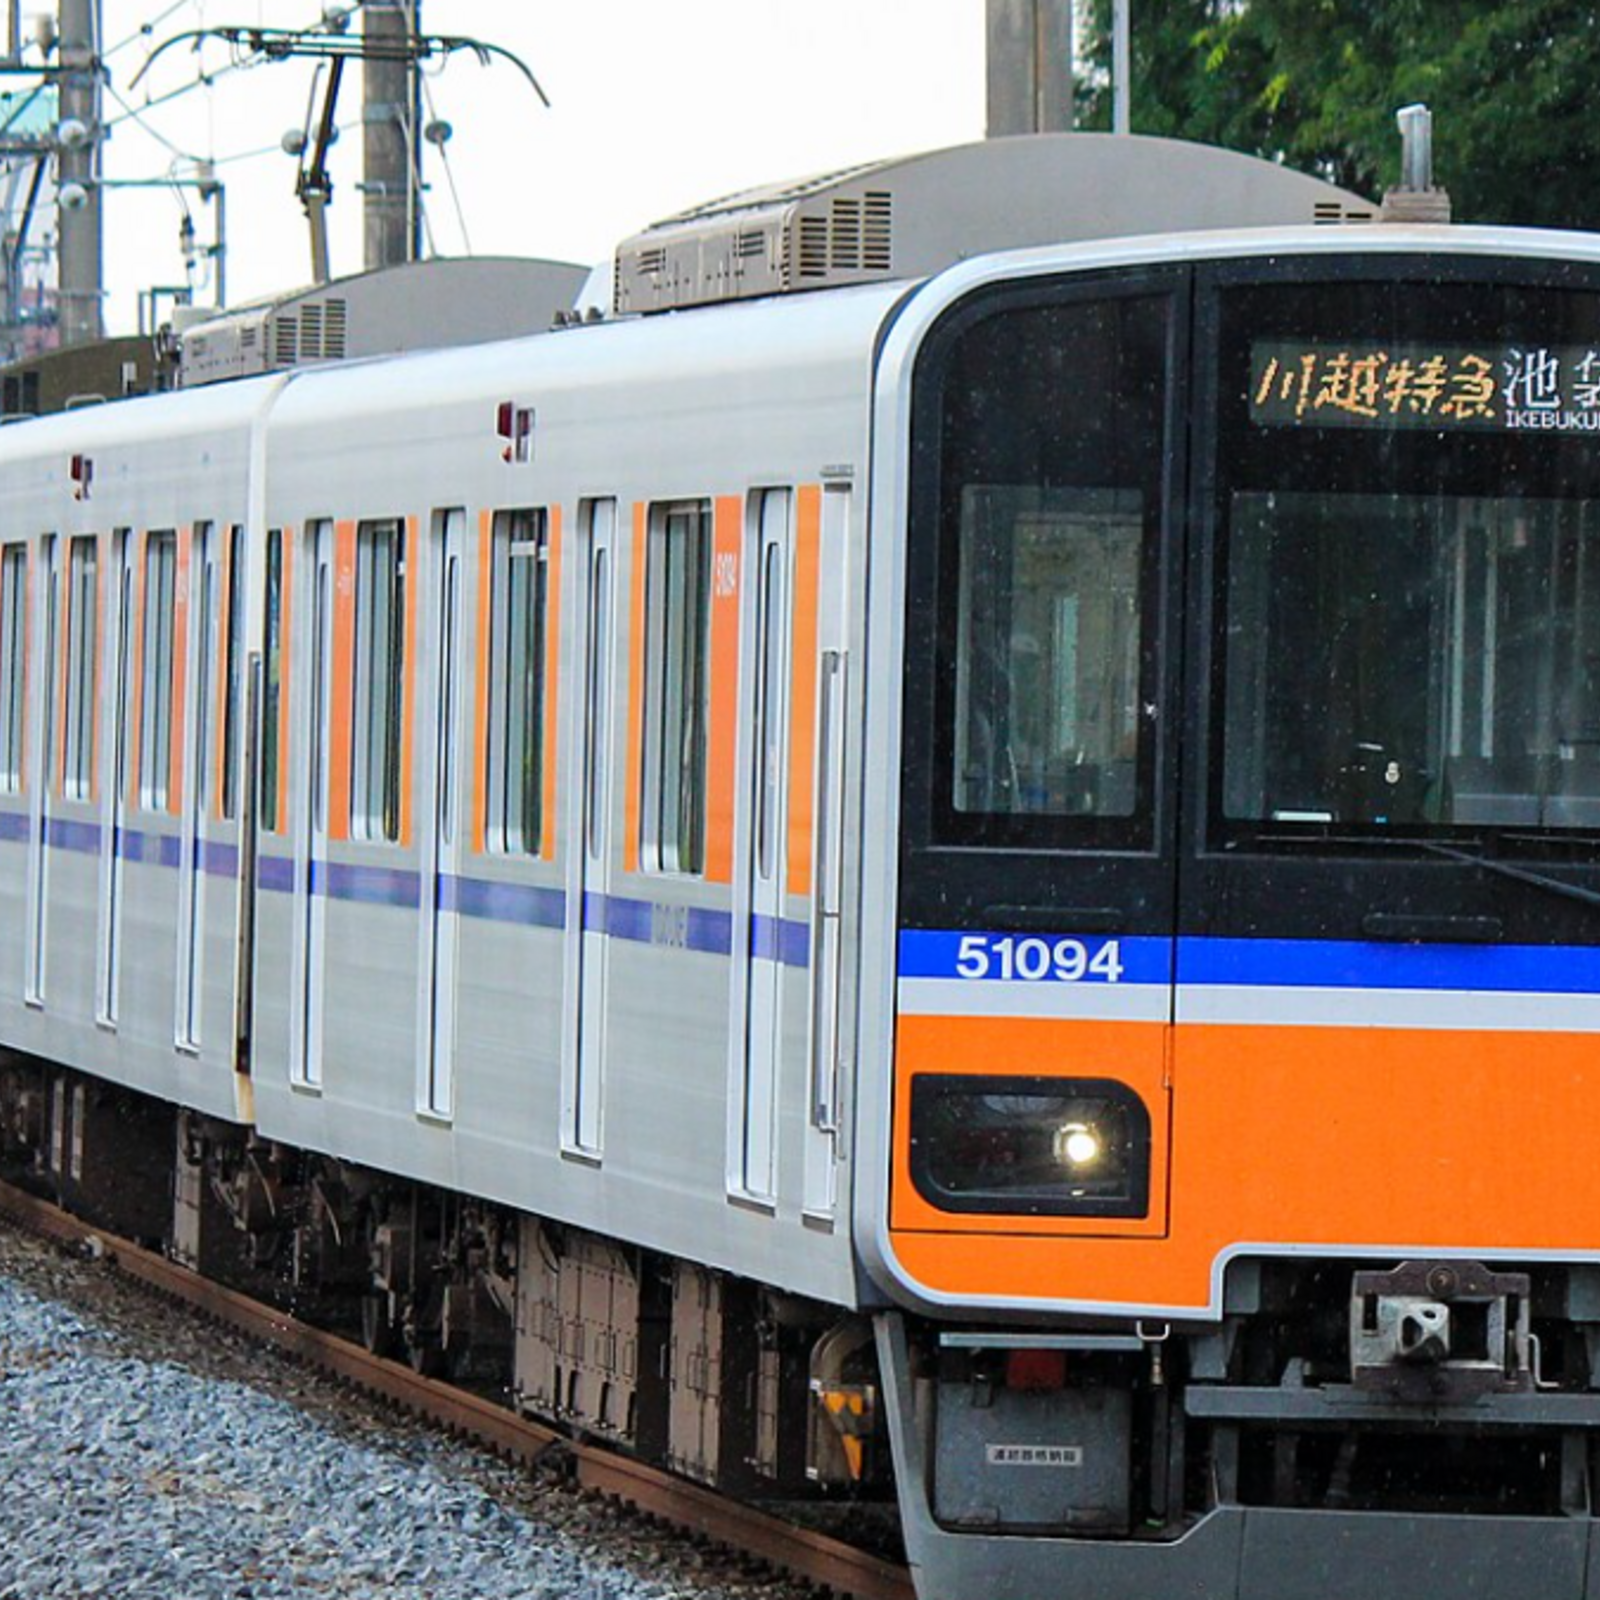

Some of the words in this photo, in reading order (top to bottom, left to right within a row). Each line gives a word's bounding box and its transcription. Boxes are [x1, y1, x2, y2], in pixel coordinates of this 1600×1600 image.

[1255, 352, 1496, 419] 川越特急
[1506, 410, 1600, 430] IKEBUKU
[956, 935, 1124, 983] 51094
